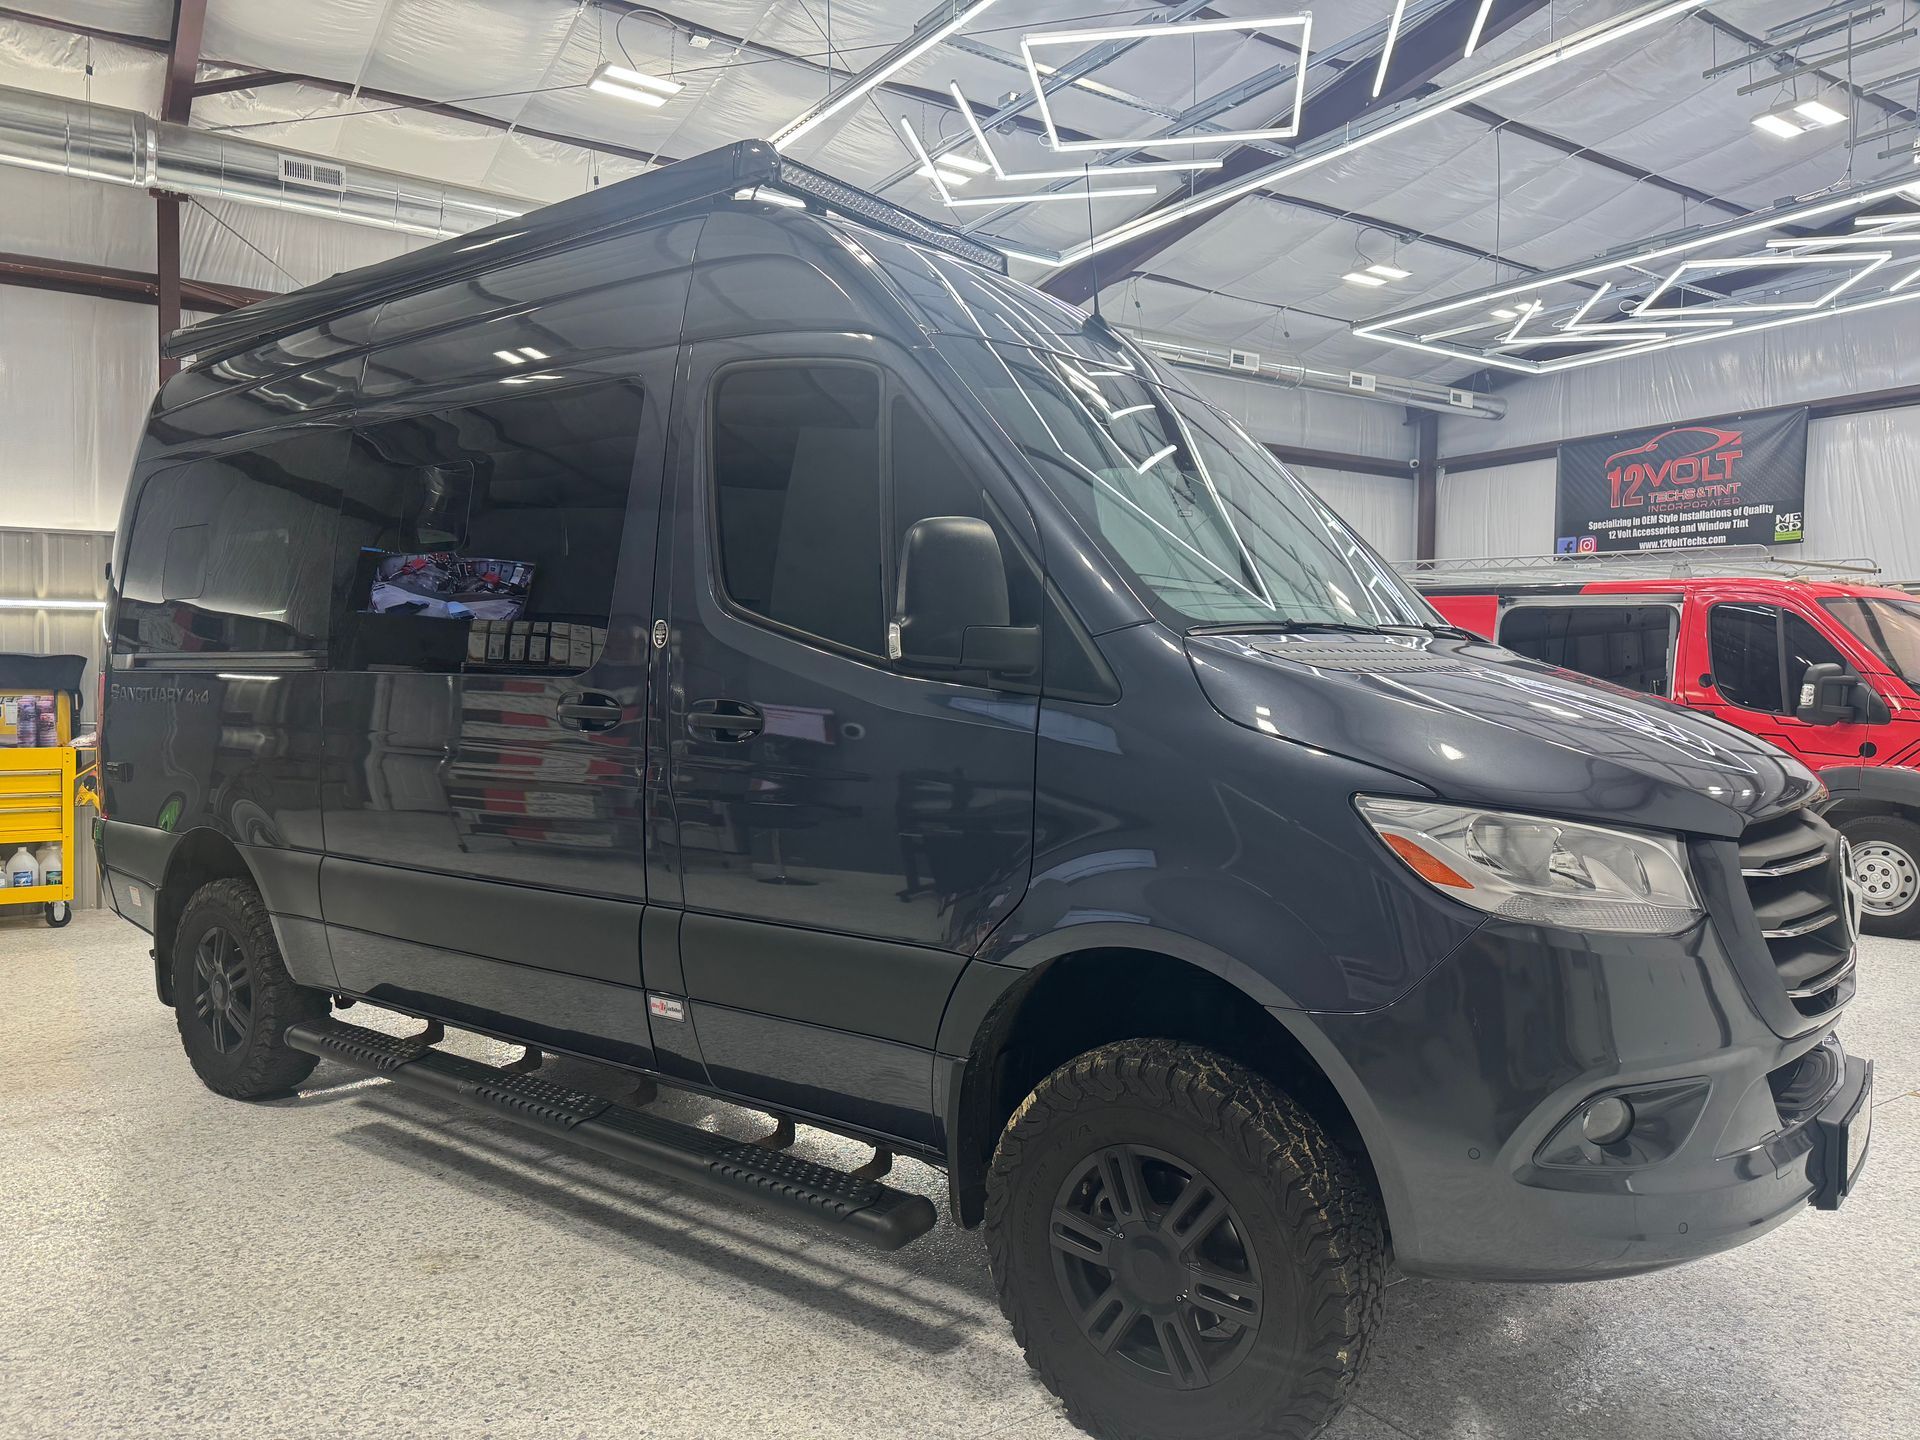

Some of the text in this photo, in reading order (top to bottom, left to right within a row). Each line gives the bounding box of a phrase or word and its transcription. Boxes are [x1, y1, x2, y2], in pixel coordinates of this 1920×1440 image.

[1648, 482, 1741, 503] TECHS&TINT
[1648, 497, 1741, 513] INCORPORATED
[1588, 518, 1632, 531] Specializing
[1642, 515, 1657, 525] OEM
[1658, 513, 1678, 524] Style
[1680, 508, 1732, 520] Installations
[1733, 507, 1743, 517] of
[1743, 504, 1774, 516] Quality
[1608, 519, 1749, 539] 12 Volt Accessories and Window Tint
[1639, 535, 1727, 550] www.12VoltTechs.com
